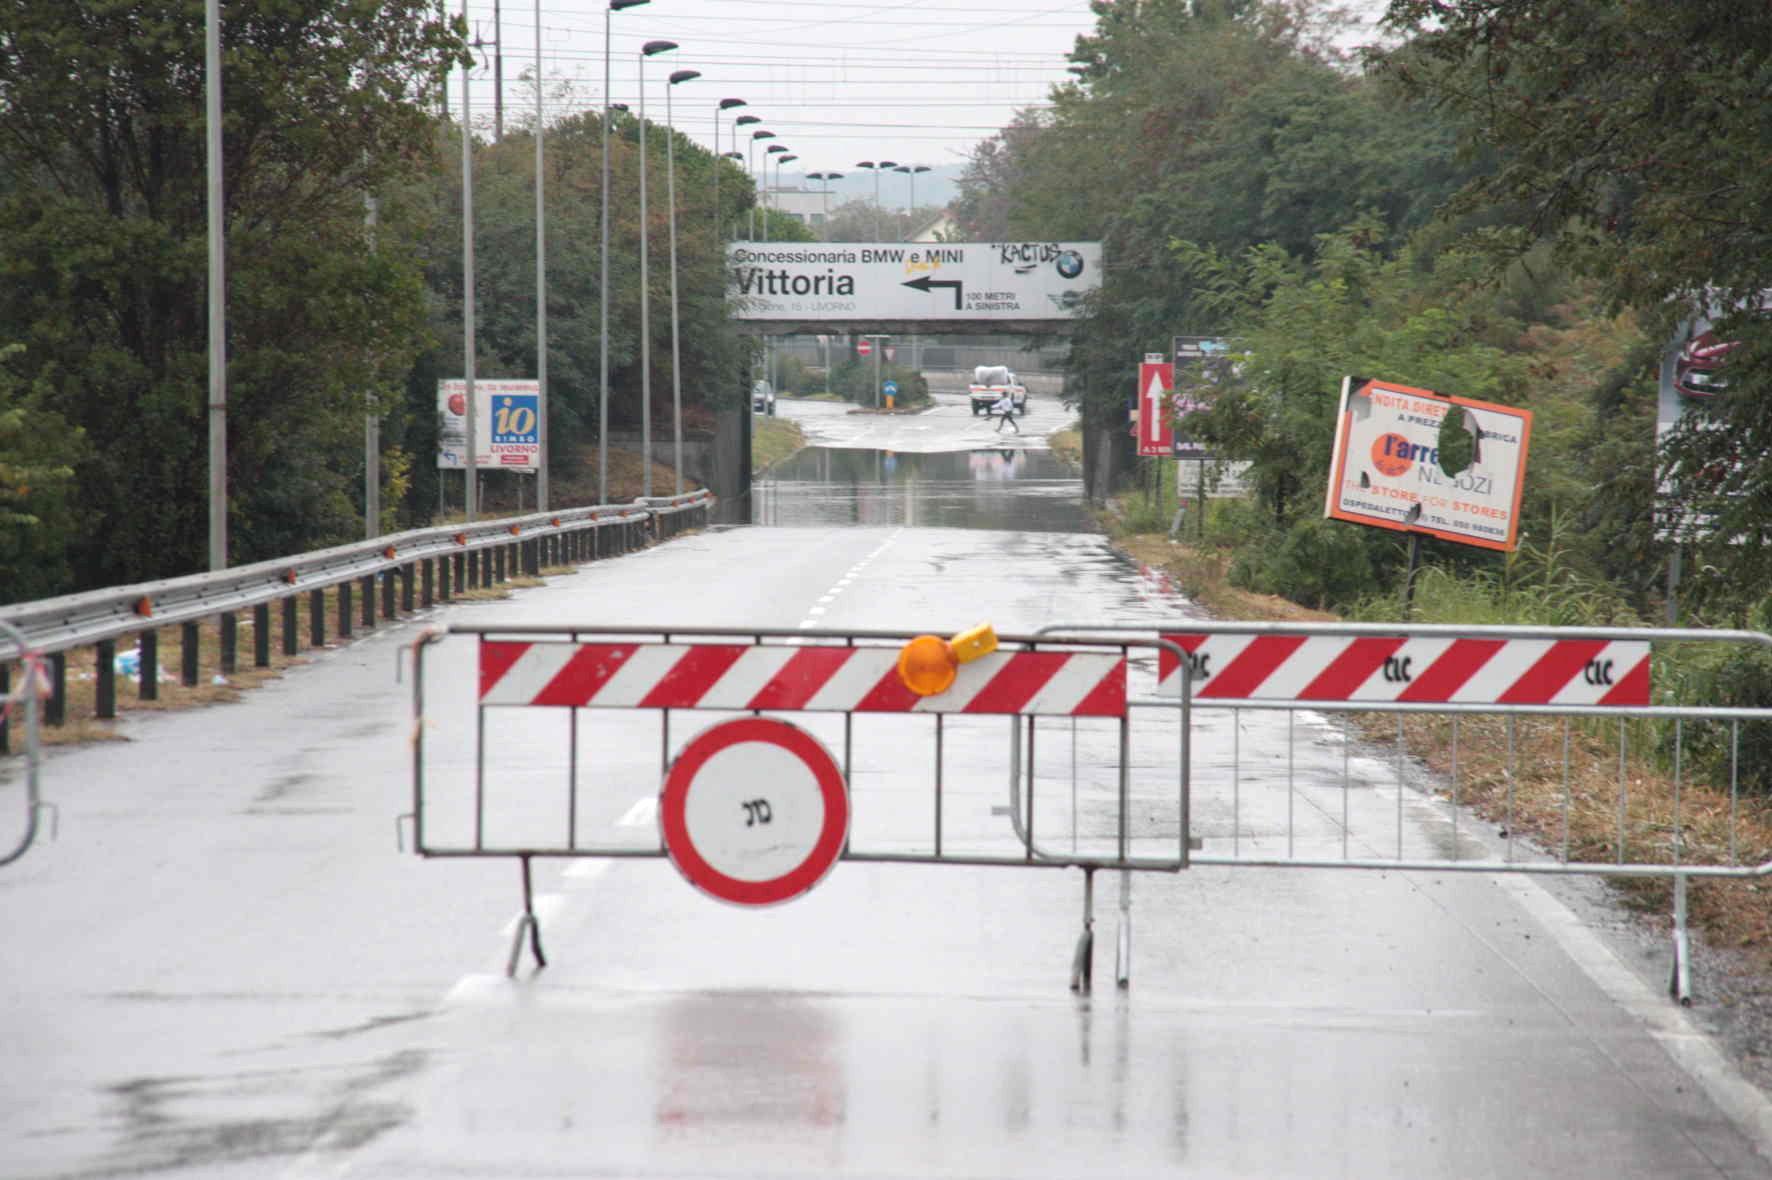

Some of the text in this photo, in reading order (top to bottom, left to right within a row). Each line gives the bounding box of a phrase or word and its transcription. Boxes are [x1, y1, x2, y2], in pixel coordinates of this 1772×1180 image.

[735, 249, 963, 263] Concessionaria BMW e MINI
[736, 267, 854, 295] Vittoria
[985, 292, 1015, 300] METRI
[1408, 415, 1440, 429] PREZZ
[1371, 485, 1419, 503] STORE
[1453, 500, 1508, 520] STORES
